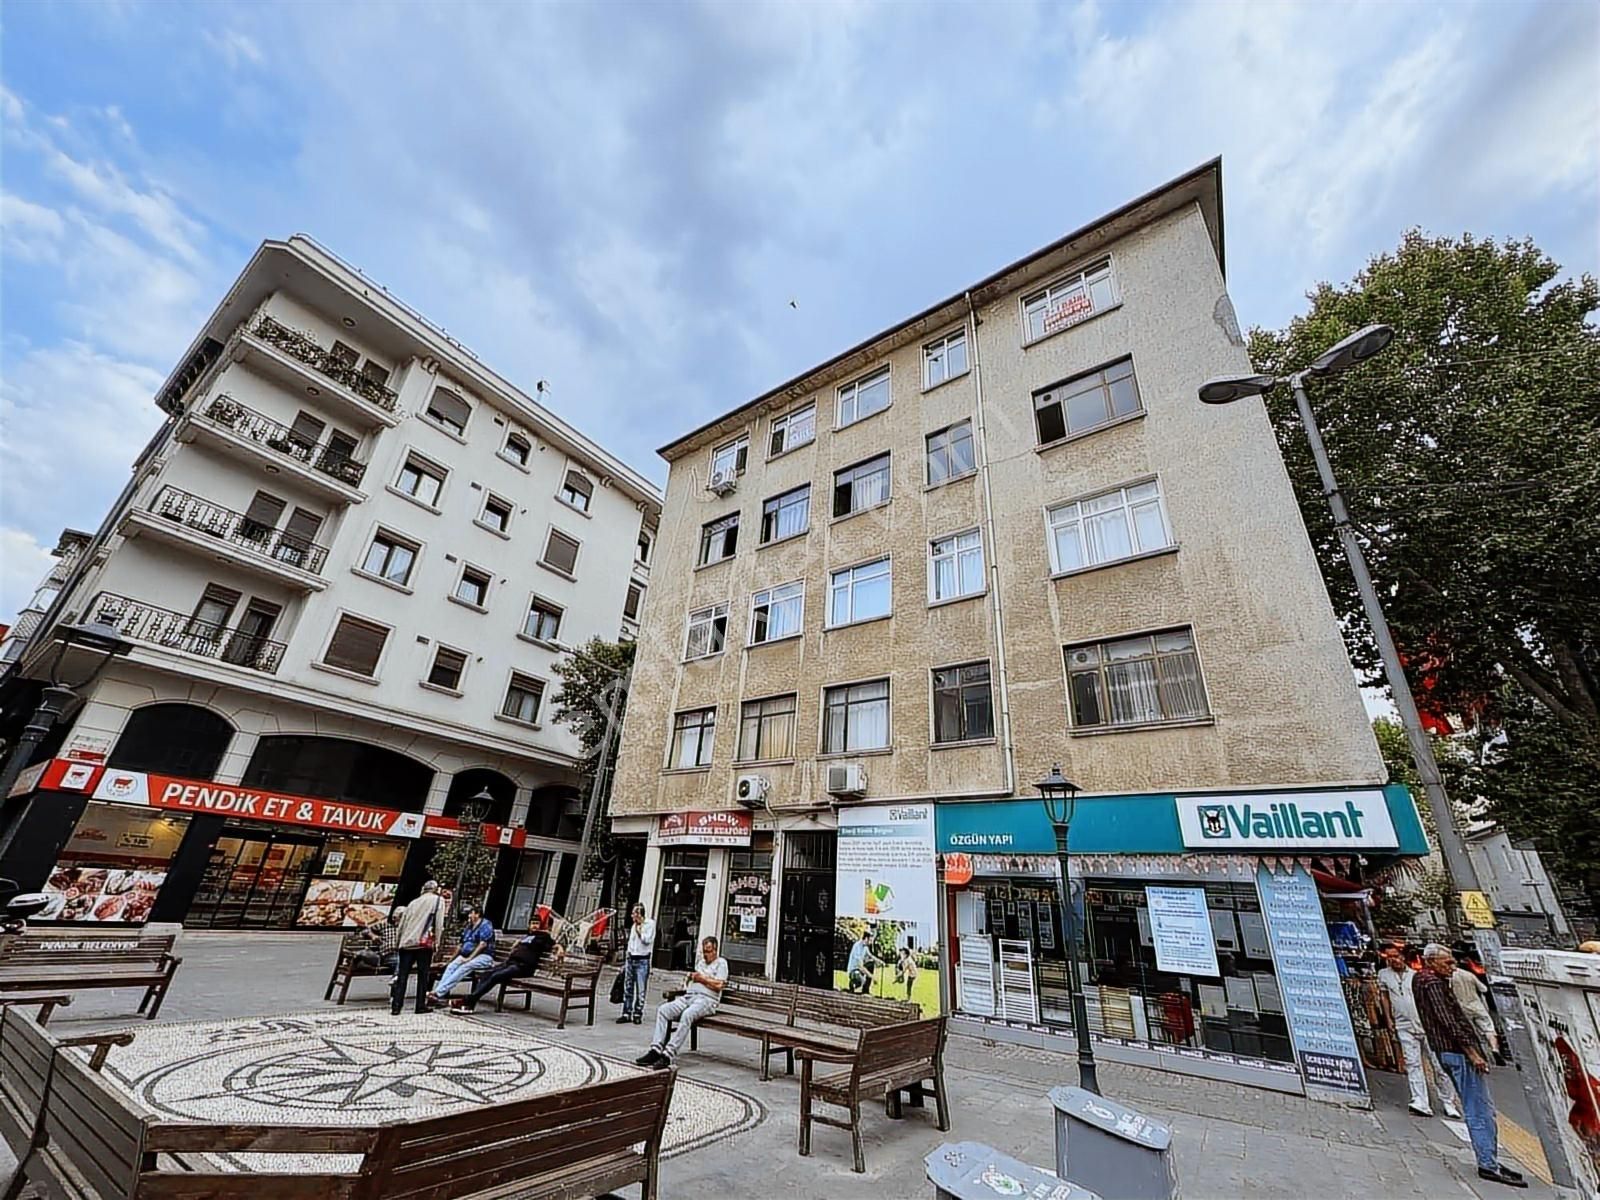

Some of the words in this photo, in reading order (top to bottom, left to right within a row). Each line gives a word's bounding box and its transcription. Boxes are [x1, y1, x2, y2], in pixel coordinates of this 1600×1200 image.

[262, 798, 294, 818] ET
[295, 801, 314, 822] &
[322, 804, 387, 830] TAVUK
[698, 812, 739, 826] SHOW
[1227, 801, 1364, 839] Vaillant
[950, 832, 986, 845] ÖZGÜN
[988, 834, 1013, 845] YAPI
